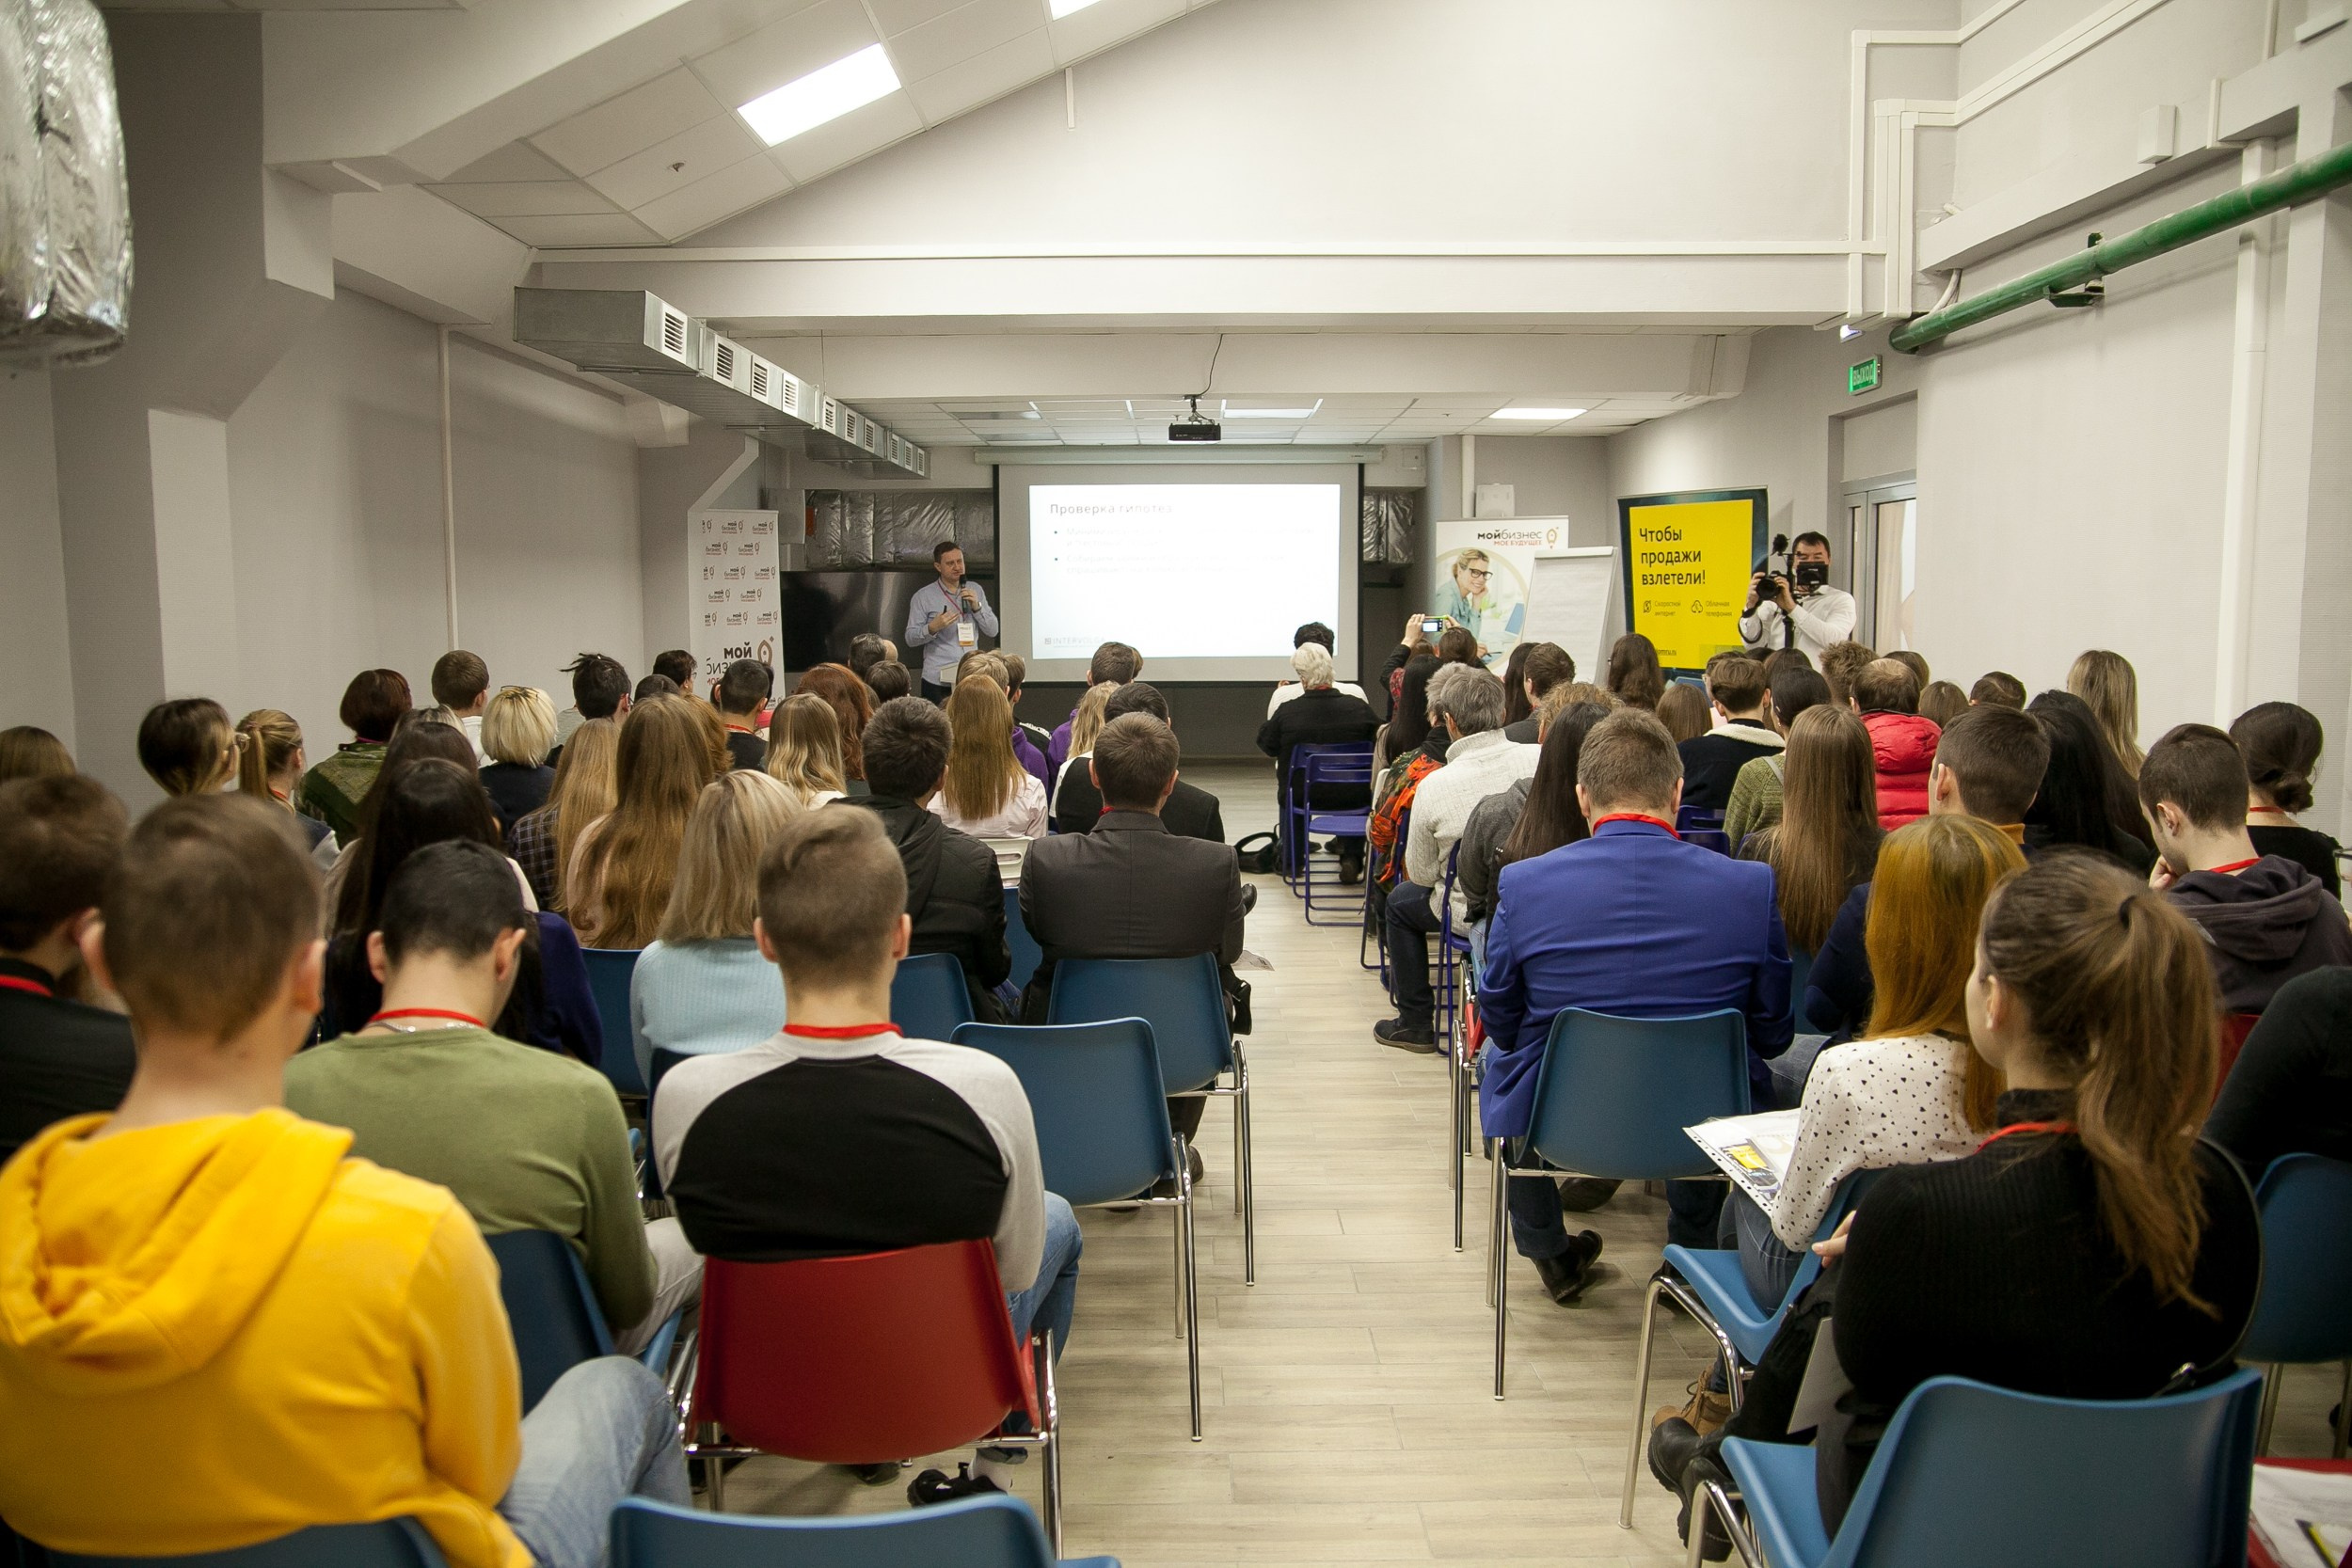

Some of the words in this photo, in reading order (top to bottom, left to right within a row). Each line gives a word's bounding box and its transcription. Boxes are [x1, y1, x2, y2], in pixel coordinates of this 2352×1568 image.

[1050, 504, 1115, 516] Проверка
[1120, 505, 1172, 514] гипотез
[1640, 526, 1682, 542] Чтобы
[1641, 550, 1702, 567] продажи
[1642, 569, 1706, 585] взлетели!
[723, 641, 753, 659] мой
